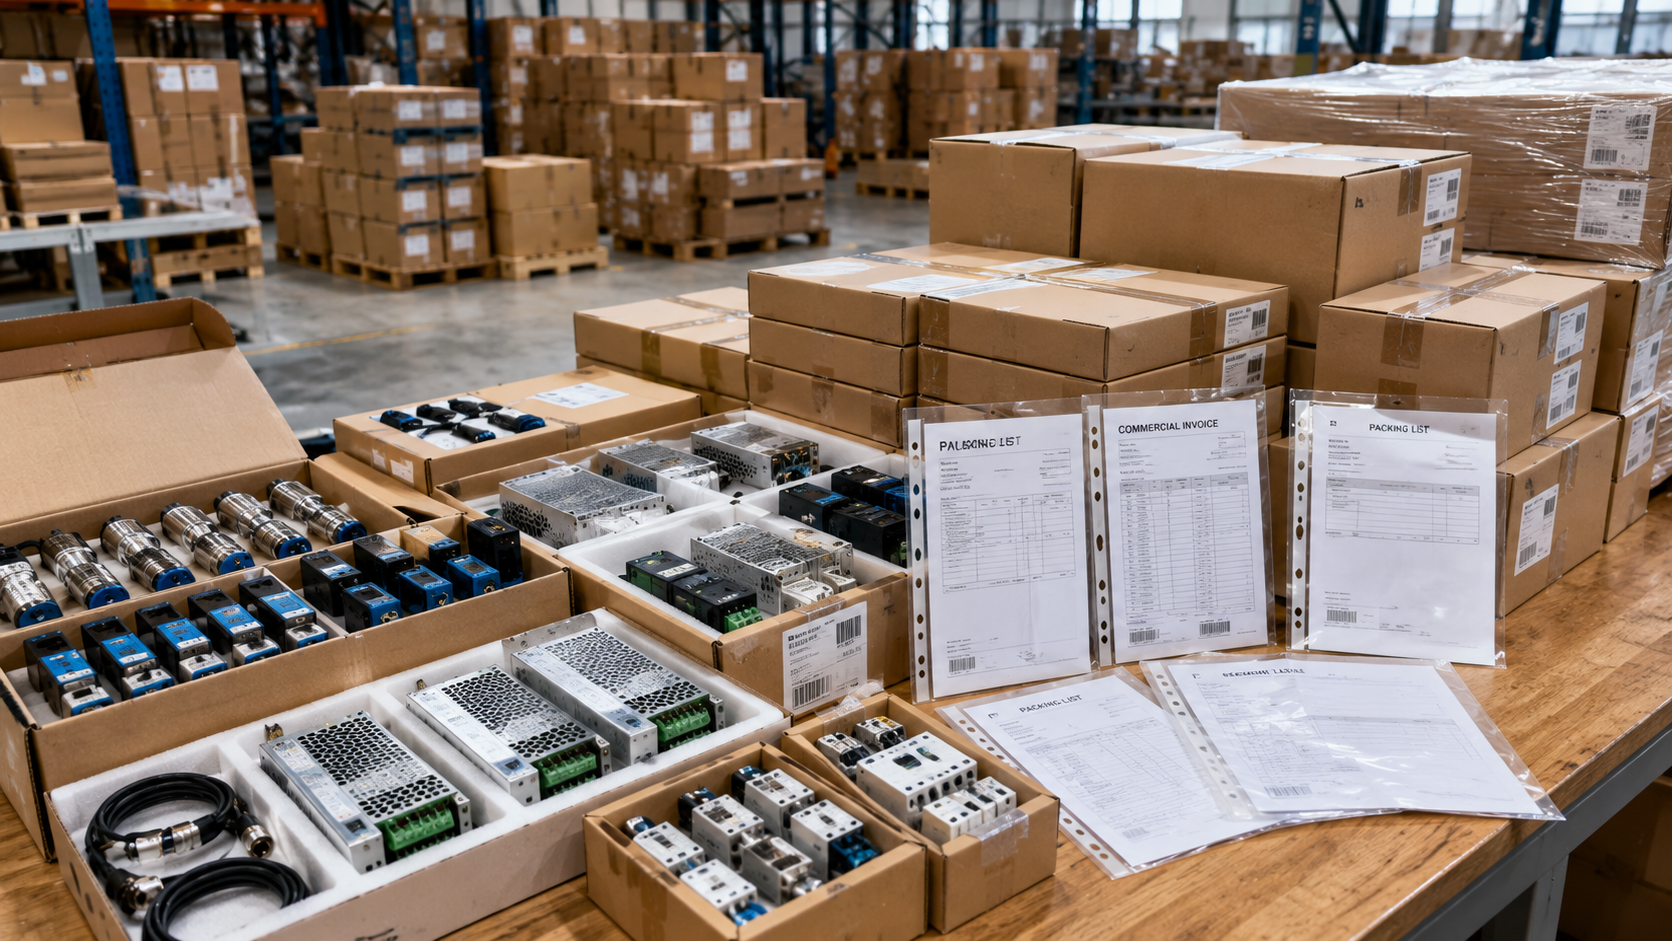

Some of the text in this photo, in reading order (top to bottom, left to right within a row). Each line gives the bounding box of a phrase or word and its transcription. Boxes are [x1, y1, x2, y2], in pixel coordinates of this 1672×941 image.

[1118, 419, 1219, 434] COMMERCIAL INVOICE
[1369, 423, 1431, 434] PACKING LIST
